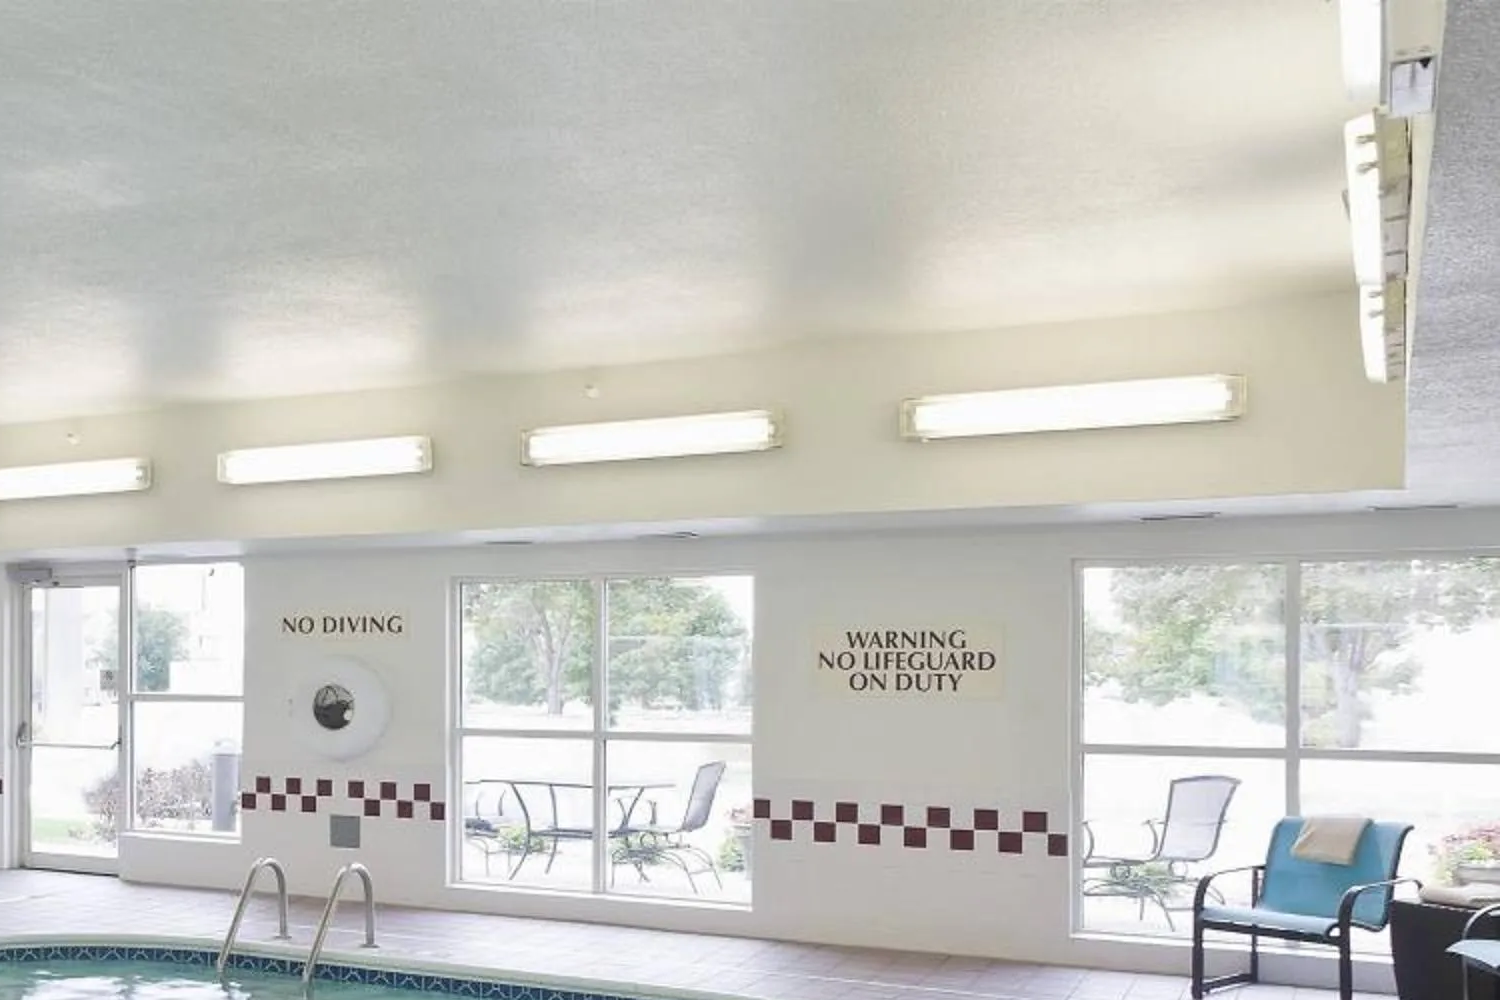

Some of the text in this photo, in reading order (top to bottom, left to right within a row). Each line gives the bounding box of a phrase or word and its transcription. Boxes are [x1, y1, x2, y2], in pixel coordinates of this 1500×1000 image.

[282, 615, 403, 634] NO DIVING
[846, 629, 967, 649] WARNING
[819, 651, 997, 671] NO LIFEGUARD
[849, 672, 963, 692] ON DUTY
